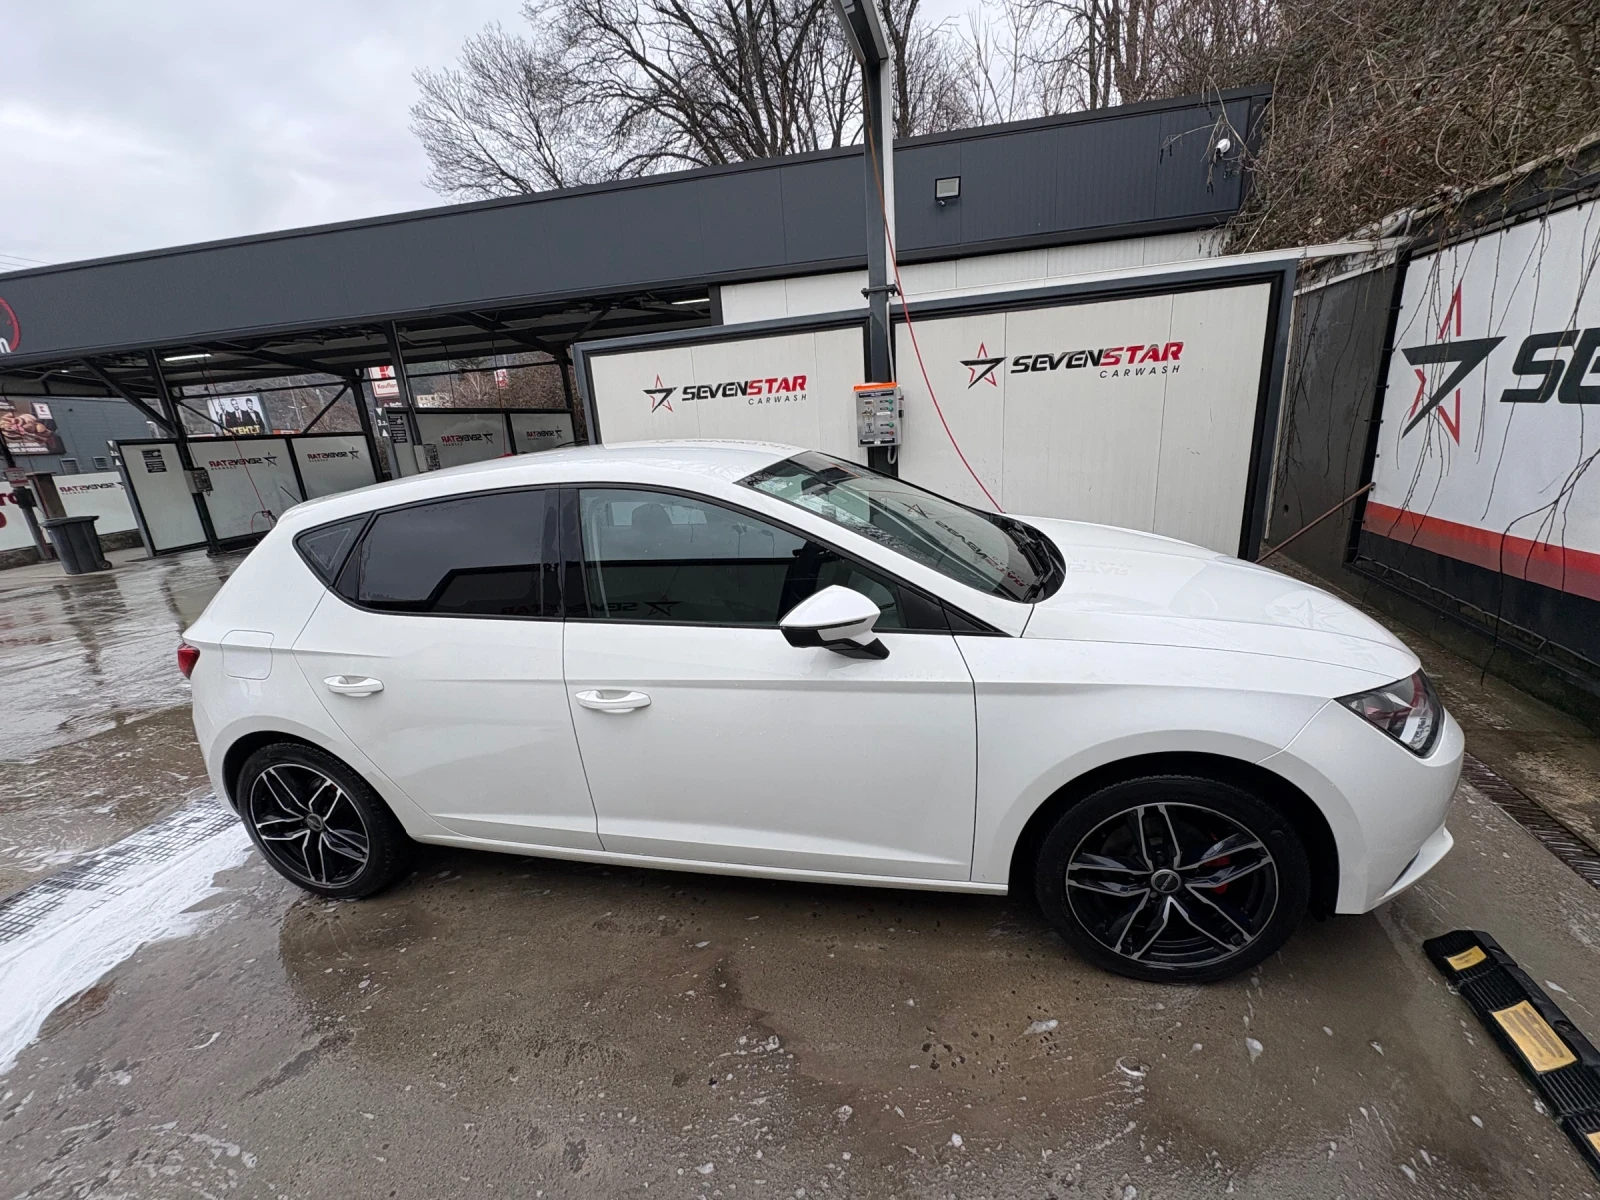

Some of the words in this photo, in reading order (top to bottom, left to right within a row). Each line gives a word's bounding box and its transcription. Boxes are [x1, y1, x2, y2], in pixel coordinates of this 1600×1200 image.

[1010, 341, 1184, 374] SEVENSTAR
[1099, 364, 1181, 379] CARWASH
[681, 374, 807, 402] SEVENSTAR
[748, 393, 807, 406] CARWASH
